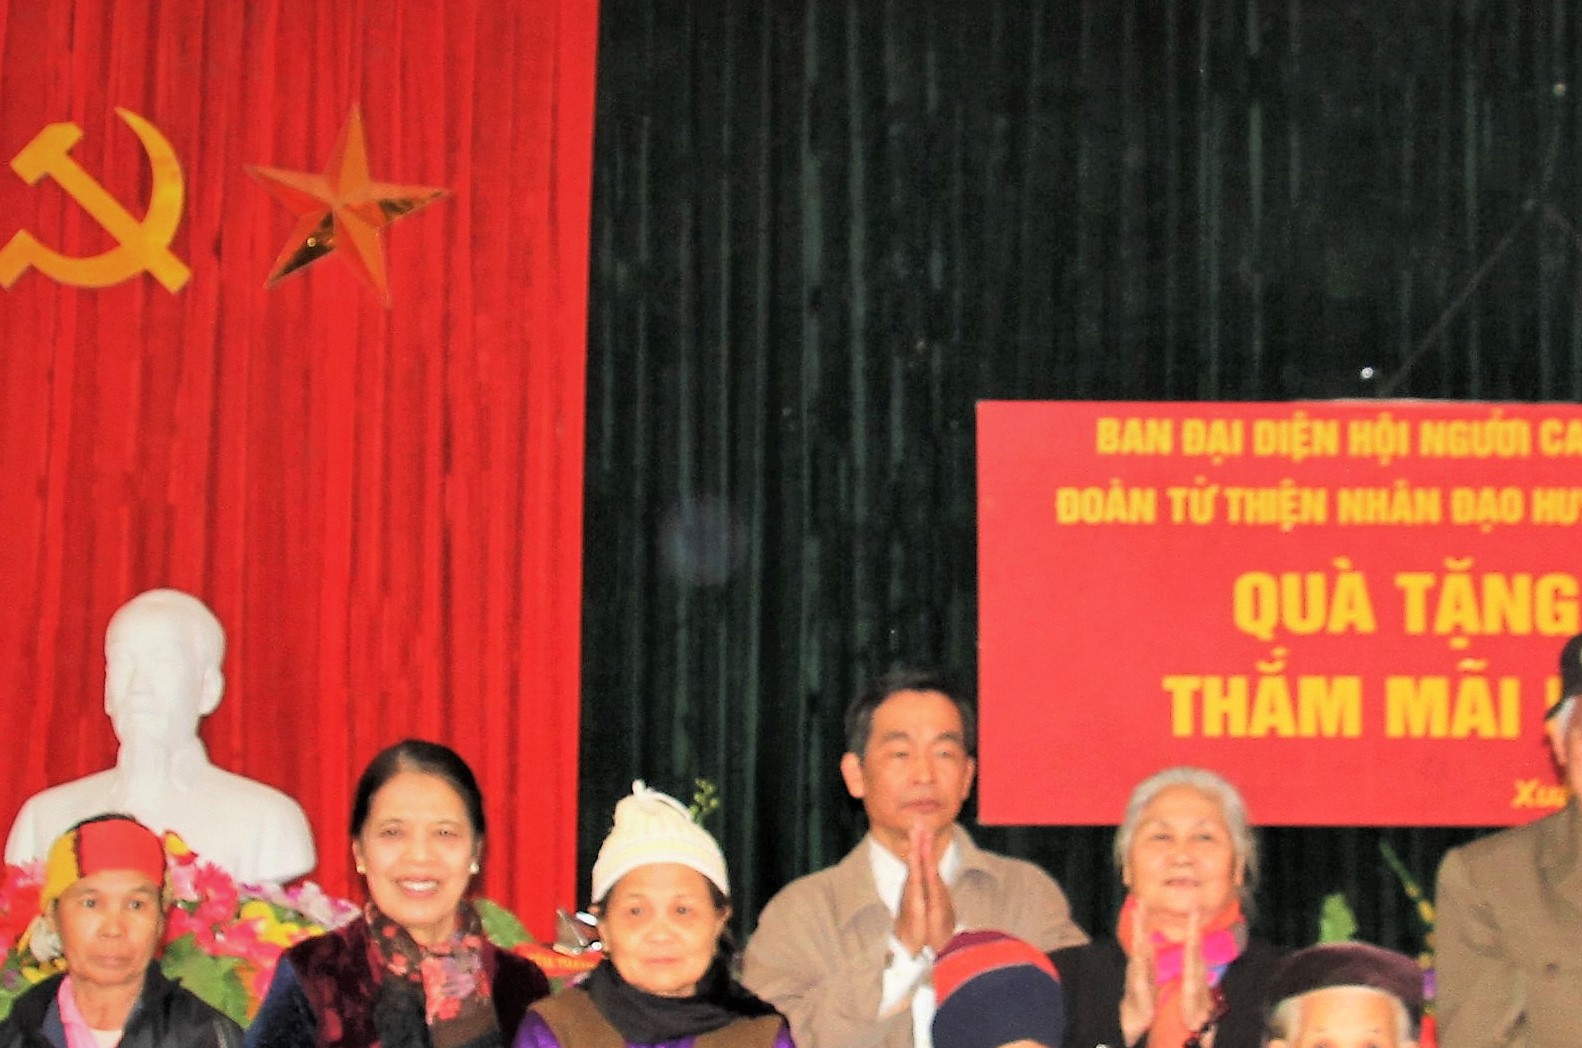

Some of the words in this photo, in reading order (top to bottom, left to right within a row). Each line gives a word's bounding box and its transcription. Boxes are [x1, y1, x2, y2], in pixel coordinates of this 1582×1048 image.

[1096, 417, 1174, 456] BAN
[1180, 418, 1245, 466] ĐẠI
[1253, 409, 1340, 463] DIỆN
[1348, 411, 1411, 467] HỘI
[1419, 408, 1531, 459] NGƯỜI
[1055, 477, 1157, 526] ĐOÀN
[1223, 478, 1328, 532] THIỆN
[1337, 478, 1442, 525] NHÂN
[1451, 487, 1525, 533] ĐẠO
[1234, 557, 1376, 641] QUÀ
[1394, 557, 1580, 650] TẶNG
[1162, 646, 1362, 738] THẮM
[1385, 658, 1520, 738] MÃI
